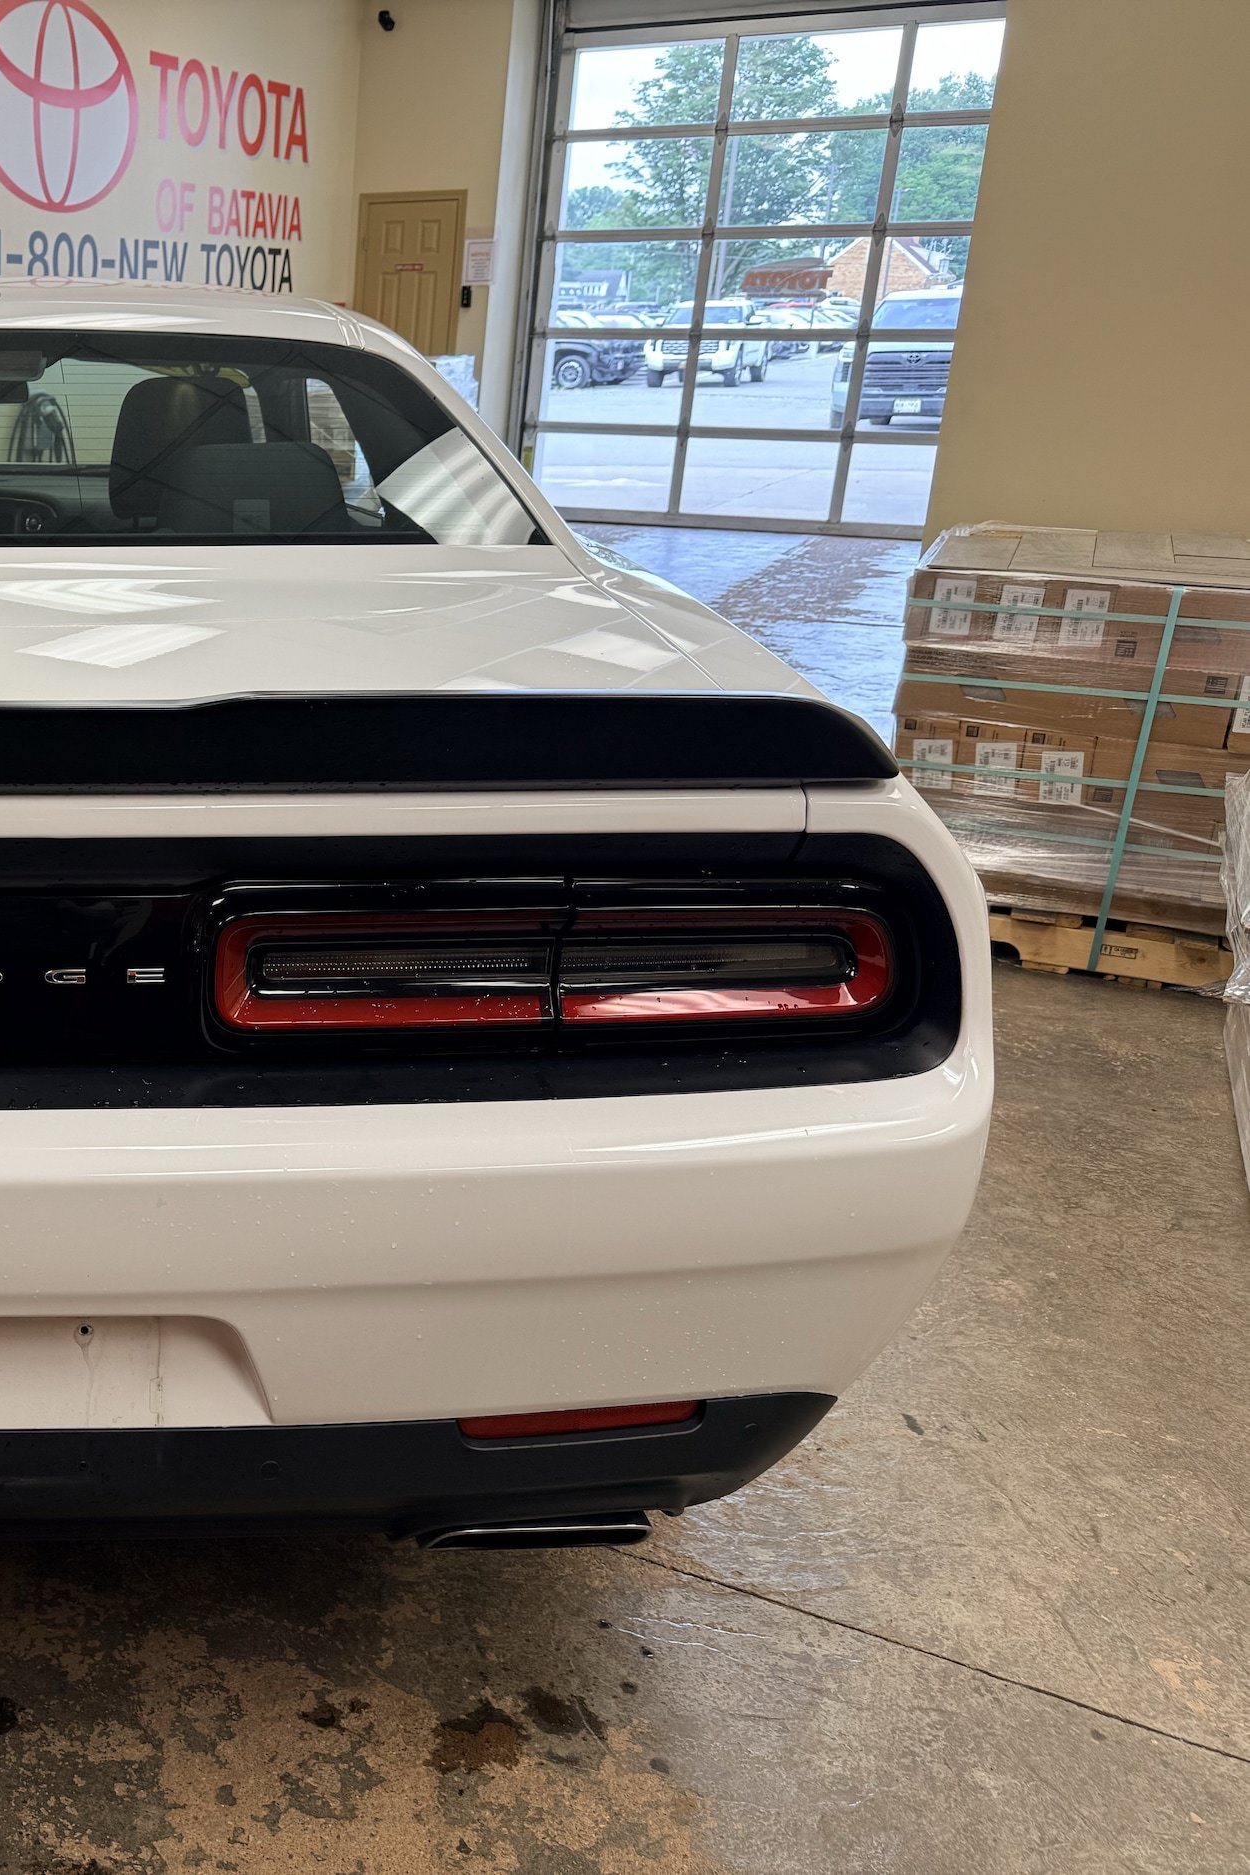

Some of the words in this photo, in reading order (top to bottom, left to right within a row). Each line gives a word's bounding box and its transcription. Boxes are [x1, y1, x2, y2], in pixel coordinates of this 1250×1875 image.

[149, 50, 308, 163] TOYOTA
[156, 179, 195, 233] OF
[207, 186, 302, 241] BATAVIA
[200, 244, 293, 293] TOYOTA
